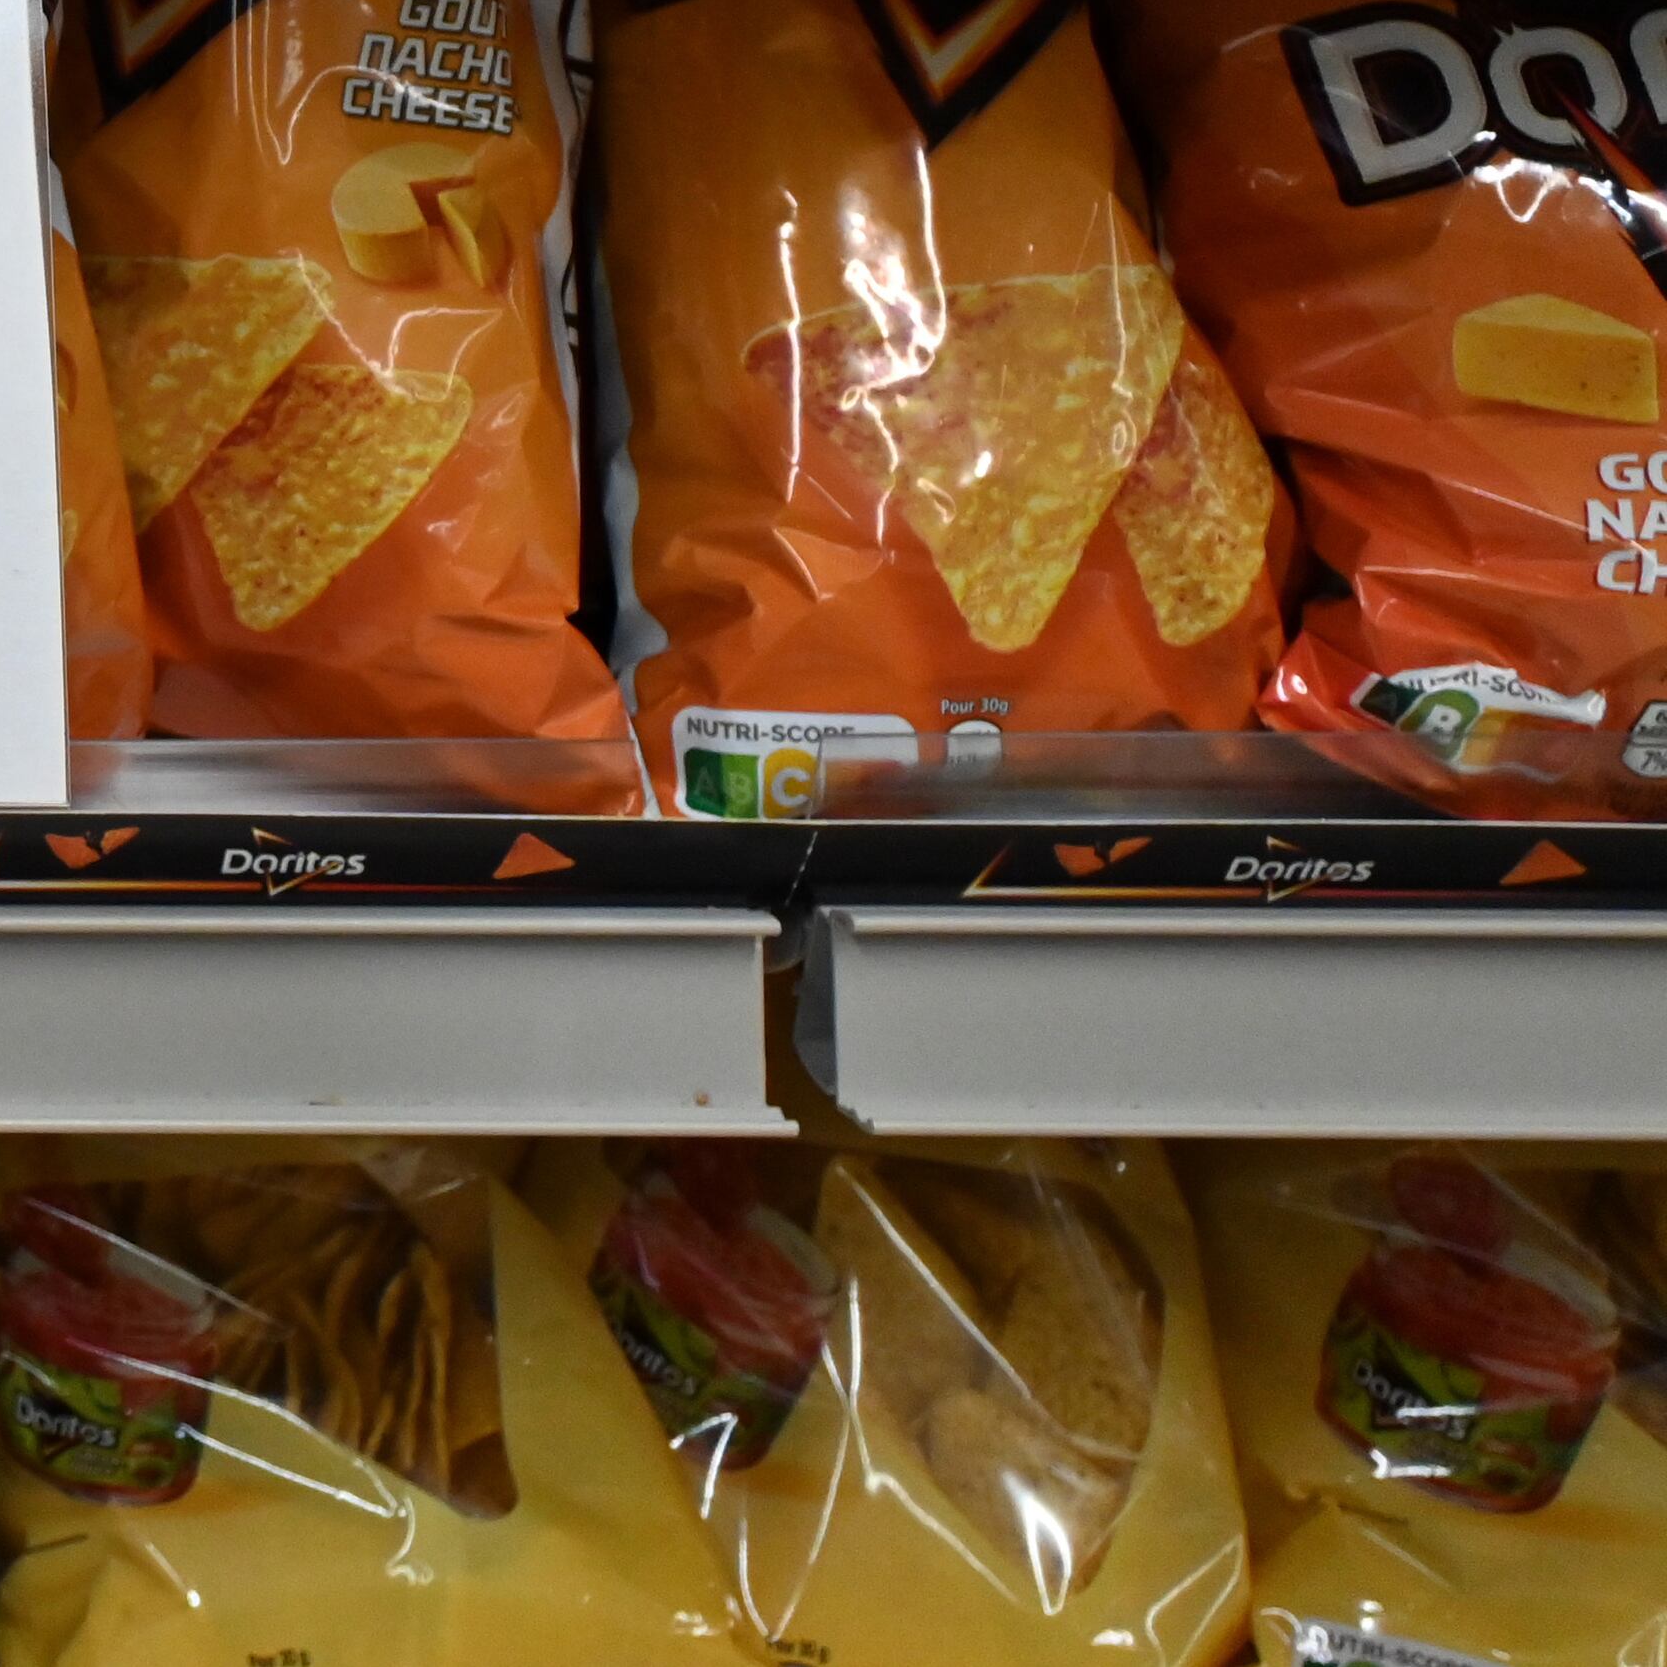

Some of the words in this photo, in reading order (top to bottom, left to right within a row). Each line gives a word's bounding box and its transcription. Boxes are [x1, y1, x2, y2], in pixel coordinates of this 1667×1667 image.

[940, 698, 974, 715] Pour
[769, 765, 811, 806] C
[220, 847, 367, 877] Doritos
[1225, 856, 1376, 884] Doritos
[14, 1392, 119, 1449] Doritos
